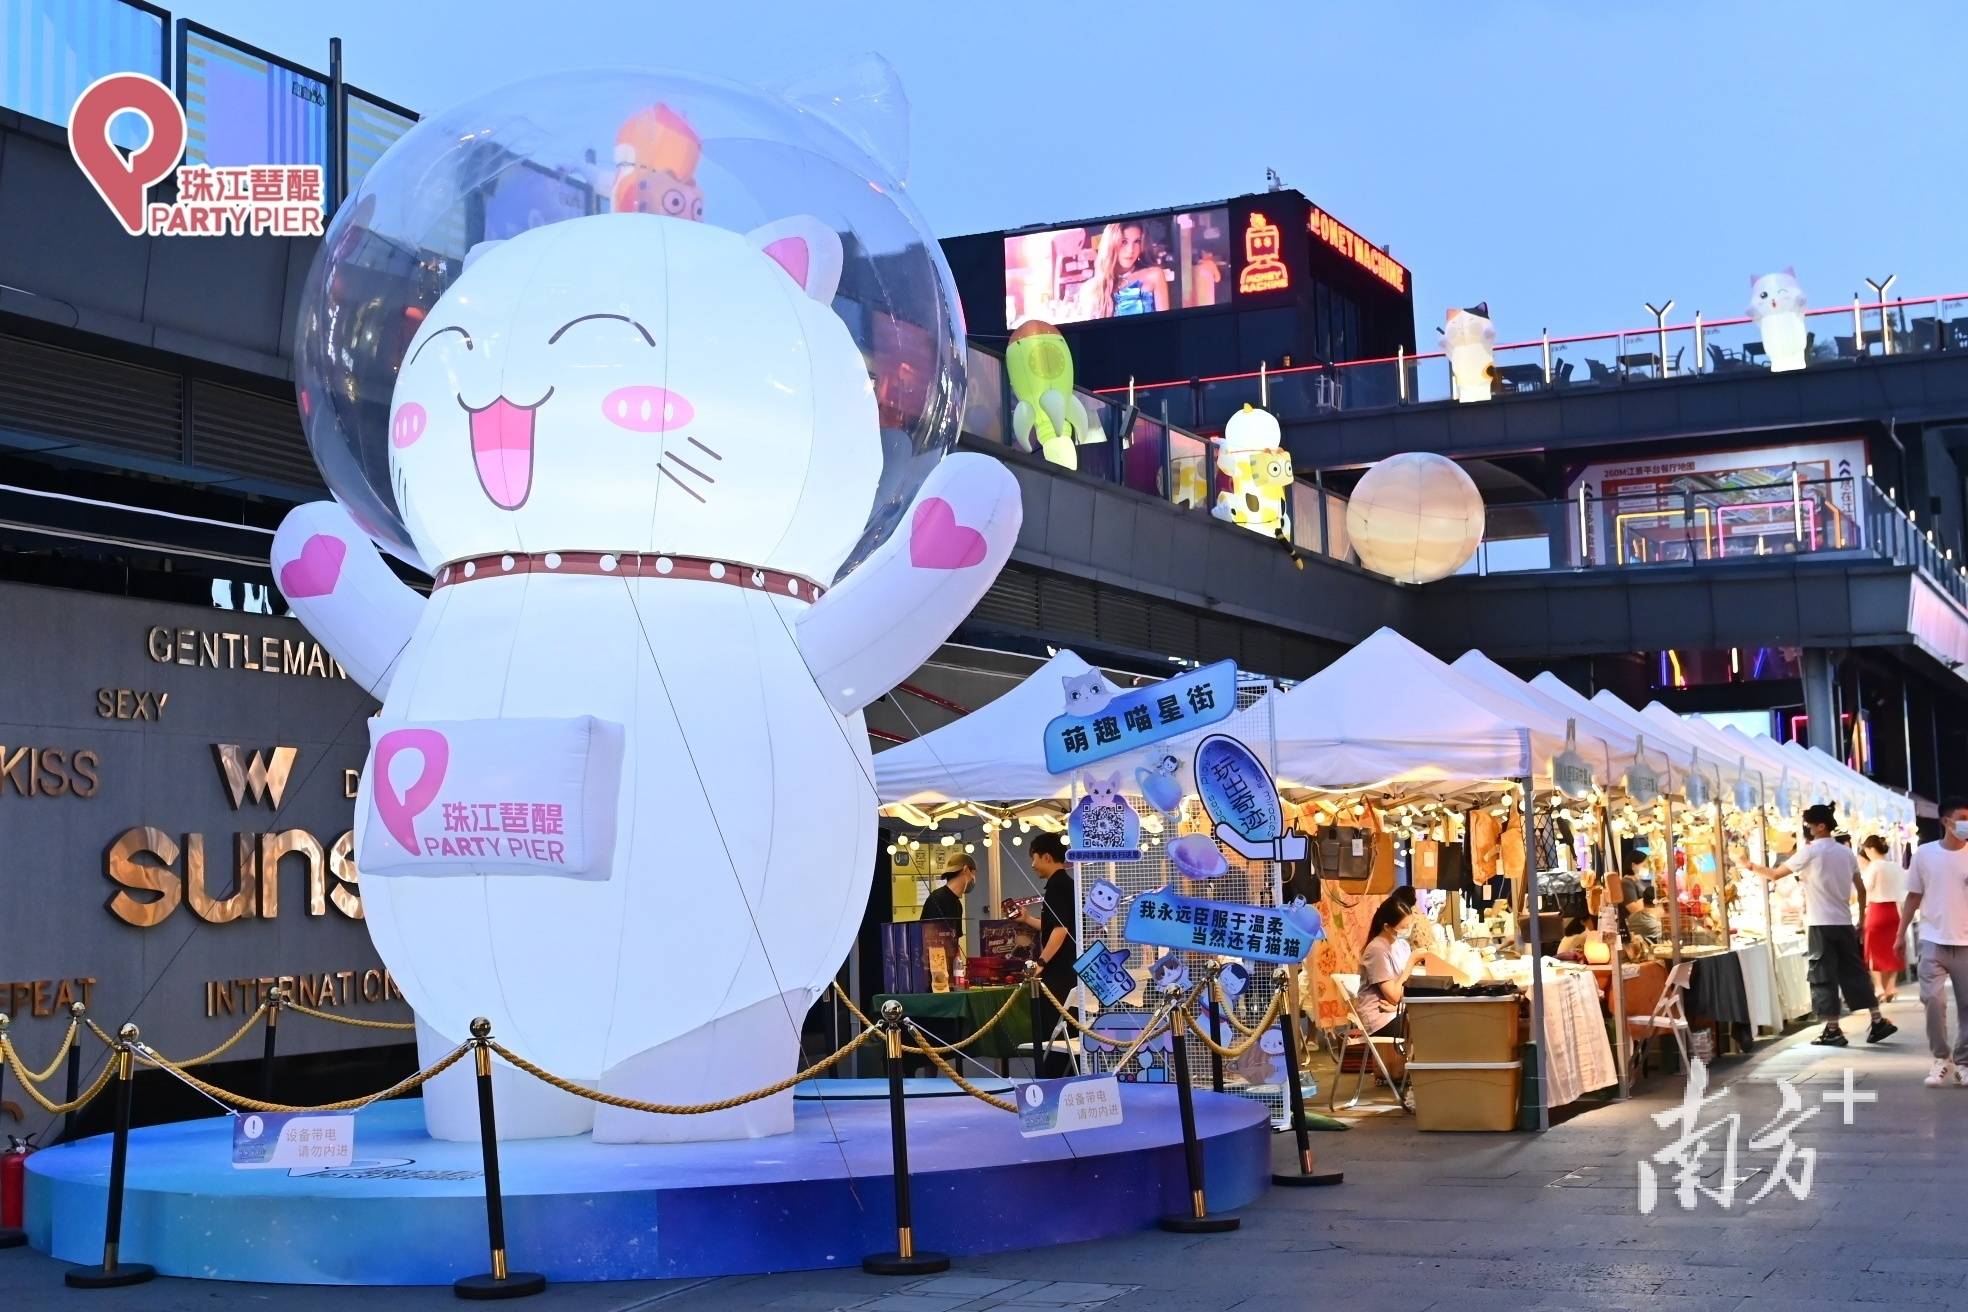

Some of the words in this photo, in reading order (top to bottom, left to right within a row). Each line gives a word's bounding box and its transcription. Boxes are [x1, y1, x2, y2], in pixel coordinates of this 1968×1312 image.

[97, 688, 168, 721] SEXY
[1061, 682, 1216, 754] 萌趣喵星街
[0, 745, 98, 798] KISS
[441, 801, 565, 836] 珠江琶醍
[423, 837, 502, 858] PARTY
[507, 837, 566, 865] PIER
[1139, 899, 1284, 937] 我永远臣服于温柔
[1191, 926, 1301, 959] 当然还有猫猫
[1099, 953, 1132, 992] GOOD
[1063, 1090, 1107, 1106] 设备带电
[1077, 1103, 1120, 1120] 请勿内进
[286, 1127, 337, 1143] 设备带电
[298, 1143, 349, 1157] 请勿内进
